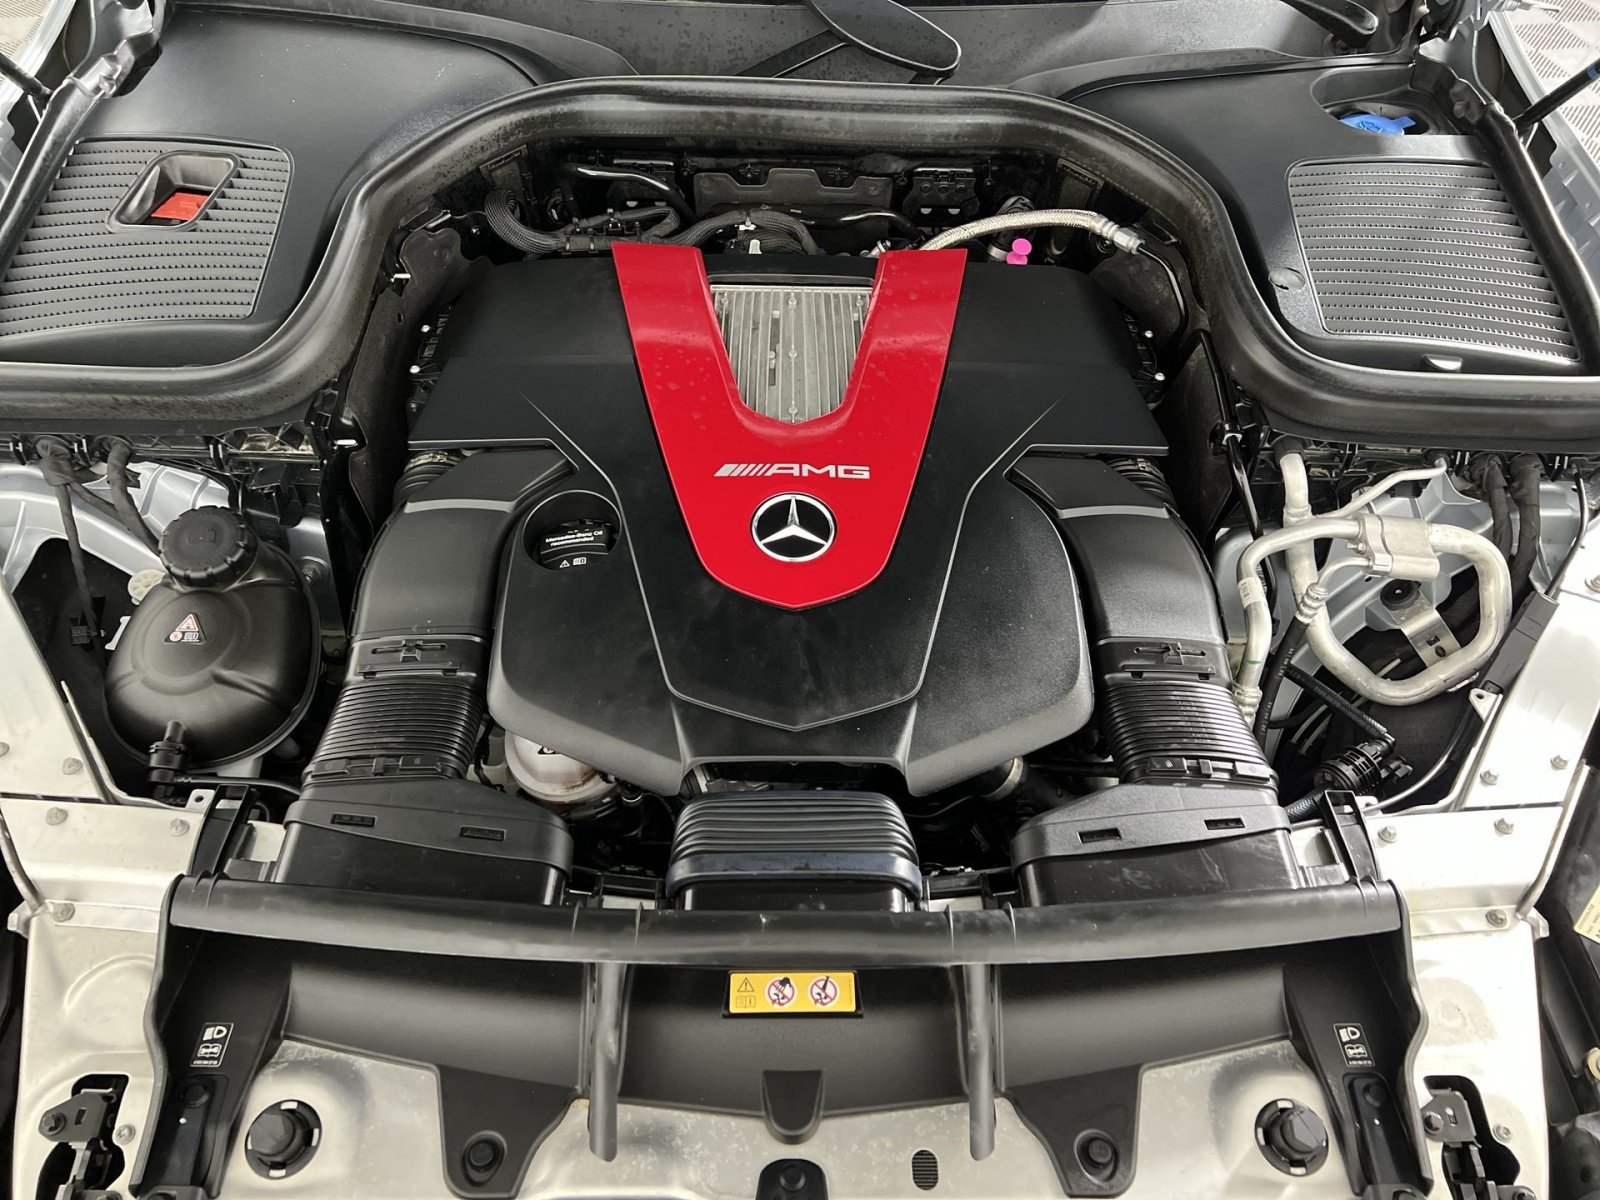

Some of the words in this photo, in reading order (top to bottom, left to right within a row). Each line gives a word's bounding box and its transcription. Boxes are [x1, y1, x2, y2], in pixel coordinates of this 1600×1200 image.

[764, 463, 870, 479] AMG
[545, 532, 593, 543] Mercedes-Benz
[550, 536, 594, 547] recommended
